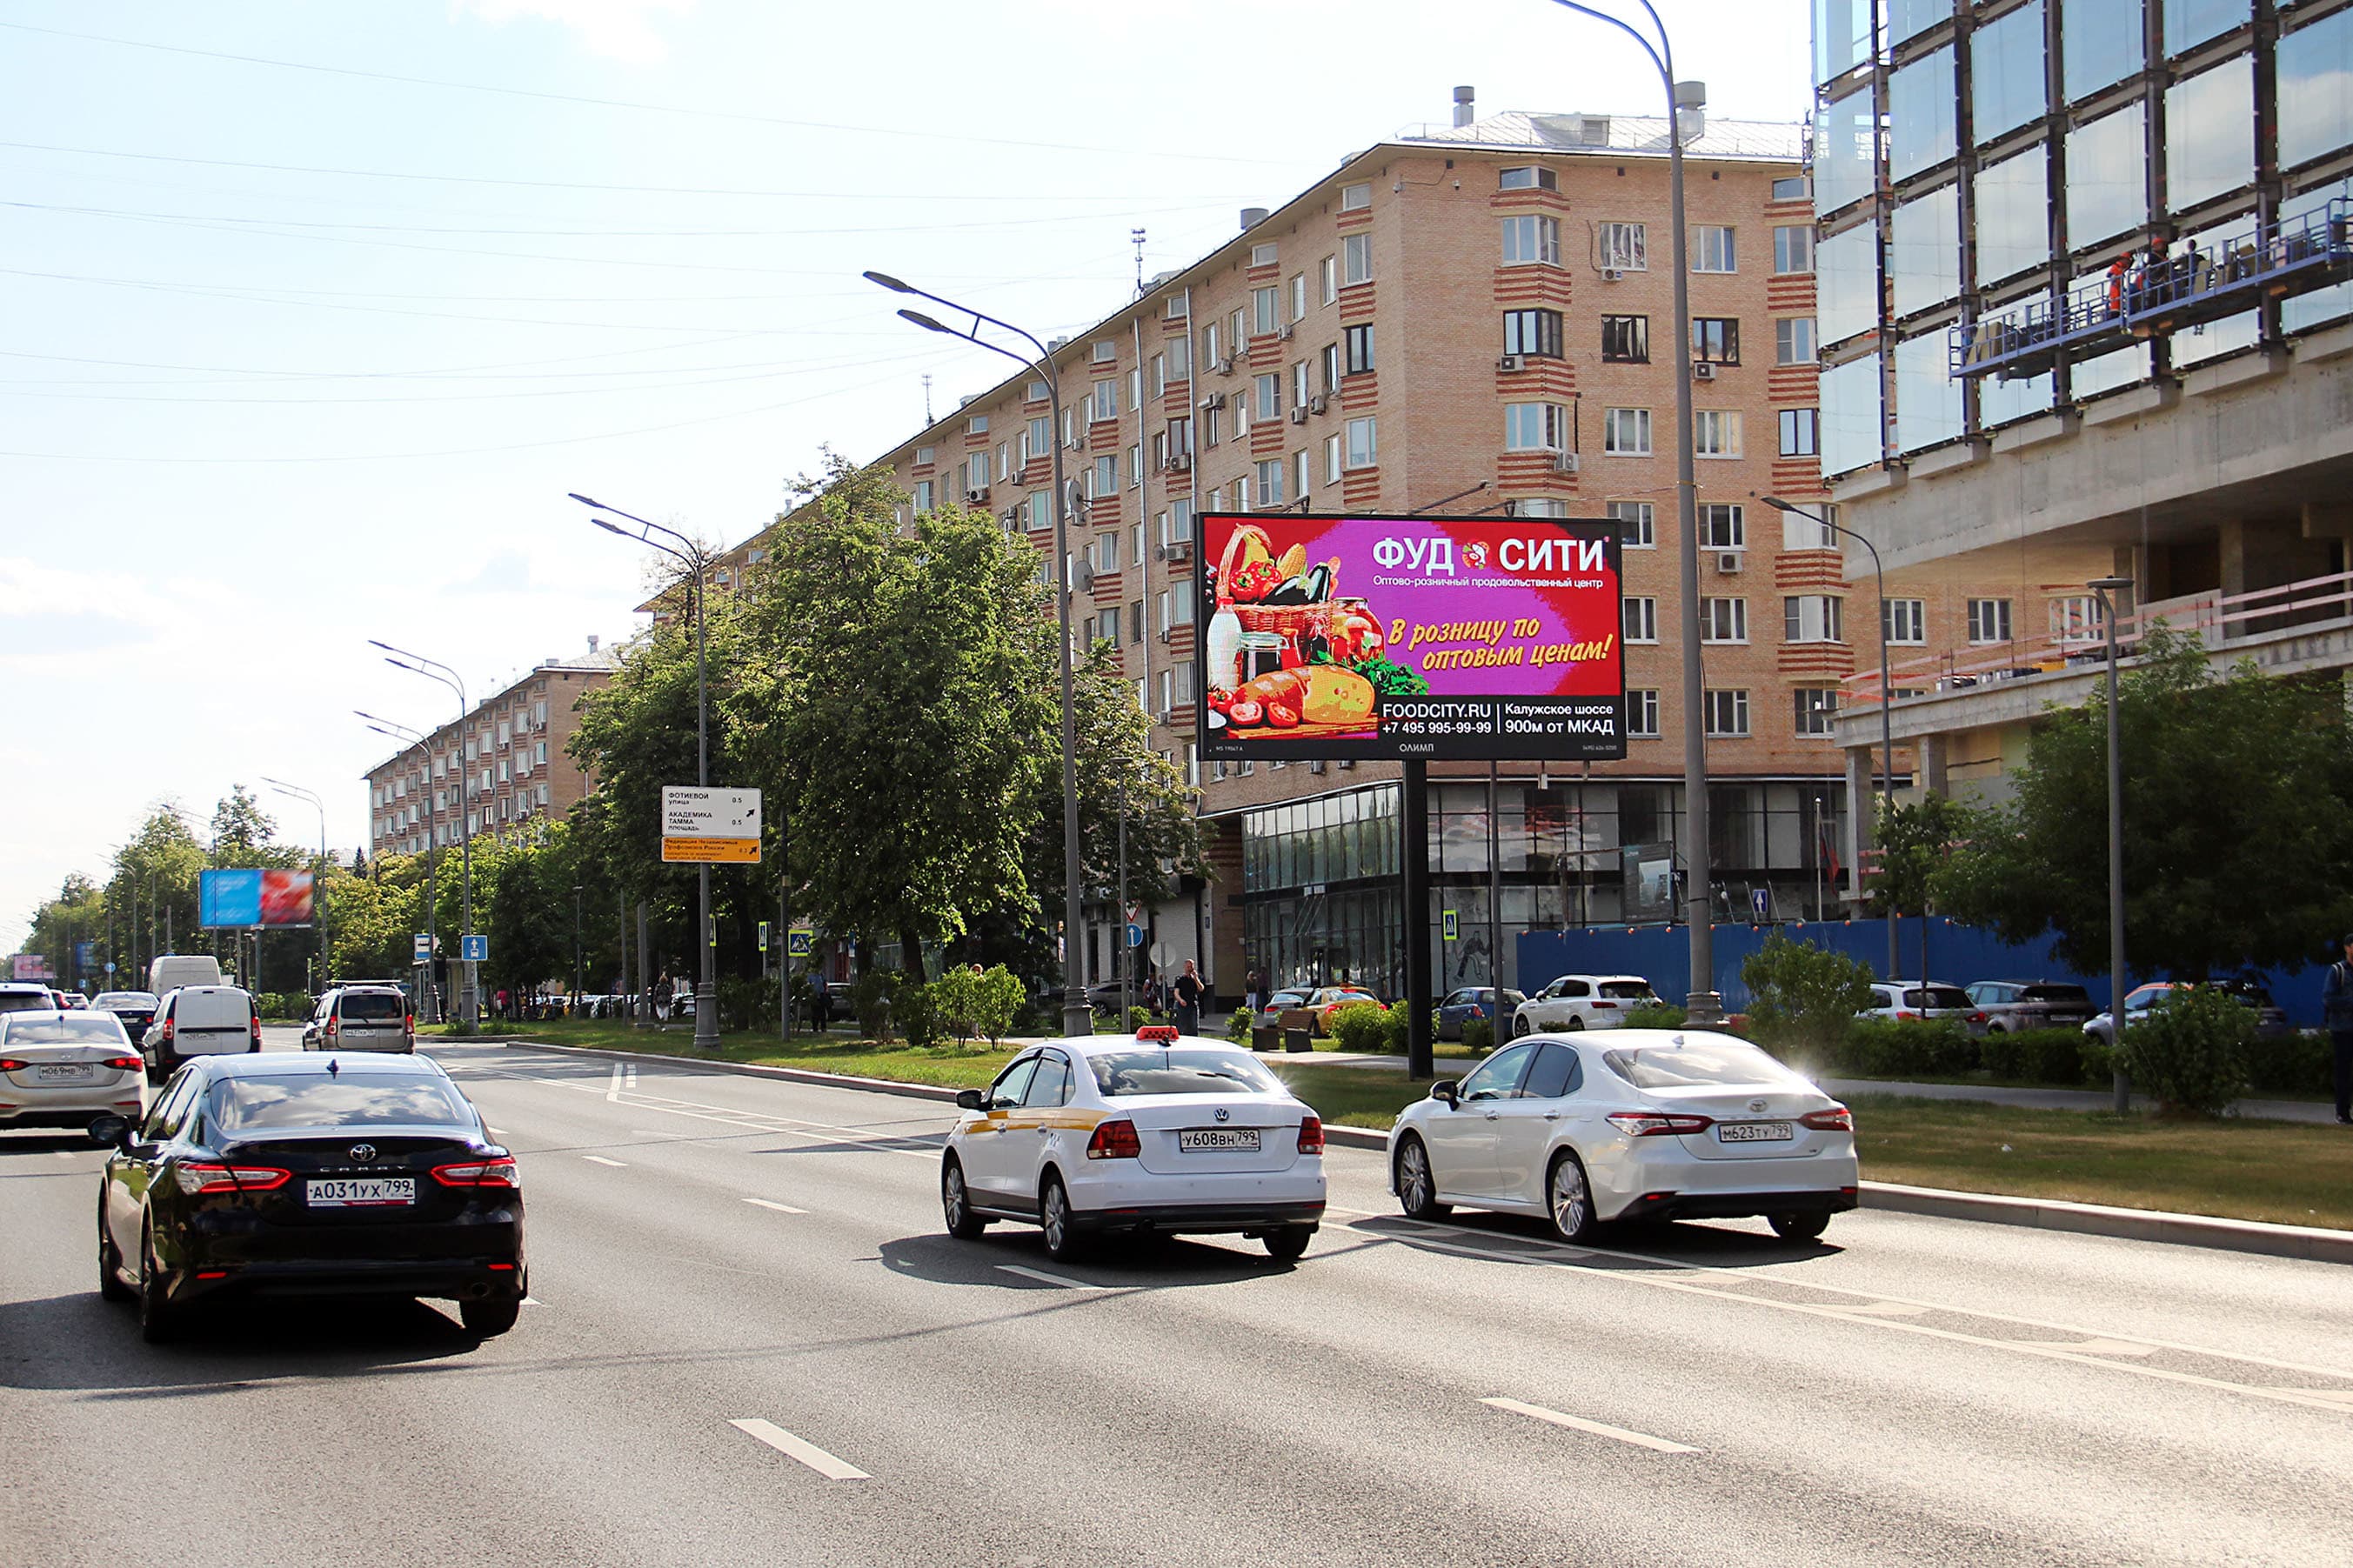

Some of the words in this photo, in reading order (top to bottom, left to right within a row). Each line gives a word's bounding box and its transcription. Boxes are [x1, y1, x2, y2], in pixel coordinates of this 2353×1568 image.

[1373, 537, 1454, 576] ФУД
[1499, 538, 1603, 571] СИТИ
[1373, 575, 1469, 588] Оптово-розничный
[1471, 577, 1572, 588] продовольственный
[1574, 579, 1603, 589] центр
[1387, 618, 1407, 644] В
[1407, 620, 1507, 651] розницу
[1512, 618, 1541, 637] по
[1422, 645, 1524, 671] оптовым
[1529, 633, 1614, 667] ценам!
[1383, 704, 1491, 717] FOODCITY.RU
[1505, 704, 1572, 717] Калужское
[1574, 705, 1614, 714] шоссе
[1382, 722, 1399, 733] +7
[1402, 722, 1425, 733] 495
[1428, 722, 1492, 733] 995-99-99
[1505, 720, 1543, 733] 900м
[1547, 723, 1563, 733] от
[1568, 719, 1614, 736] МКАД
[1399, 744, 1434, 752] ОЛИМП
[1186, 1132, 1234, 1145] У608ВН
[1237, 1131, 1255, 1141] 799
[314, 1182, 380, 1198] А031УХ
[384, 1180, 411, 1192] 799
